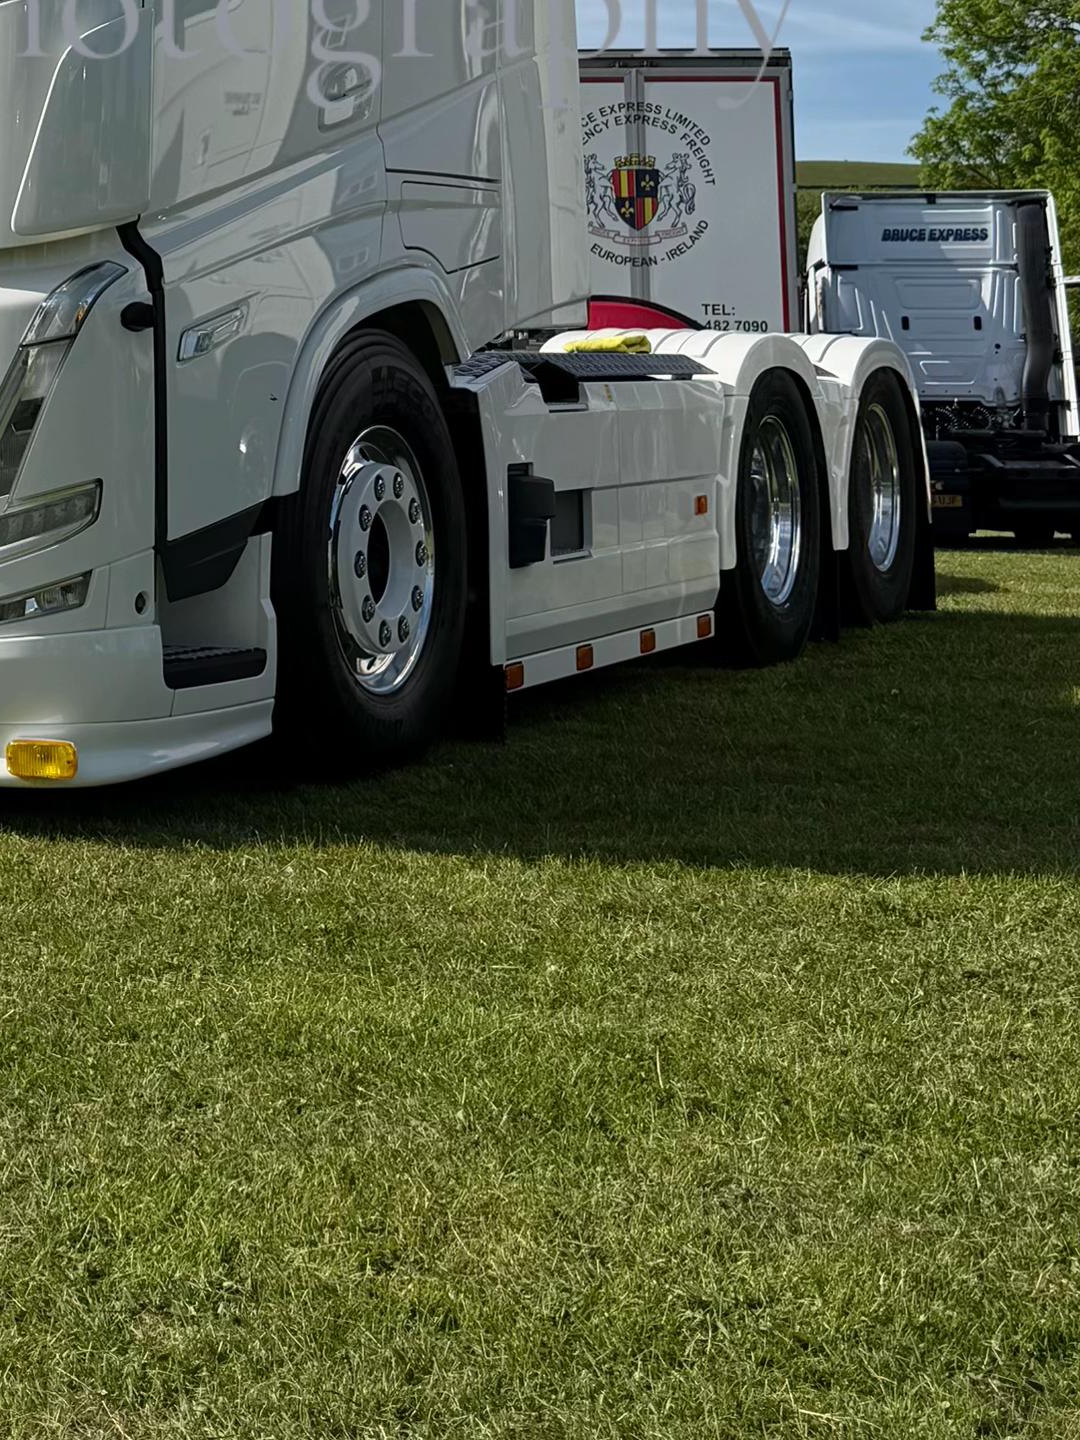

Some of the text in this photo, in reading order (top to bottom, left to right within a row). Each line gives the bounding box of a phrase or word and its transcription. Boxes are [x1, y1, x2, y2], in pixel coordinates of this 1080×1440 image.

[599, 101, 662, 117] EXPRESS
[666, 108, 711, 146] LIMITED
[614, 114, 678, 135] EXPRESS
[680, 127, 716, 186] FREIGHT
[590, 243, 658, 268] EUROPEAN
[666, 219, 709, 262] IRELAND
[881, 227, 989, 243] BRUCE EXPRESS
[701, 303, 736, 316] TEL:
[734, 320, 768, 333] 7090
